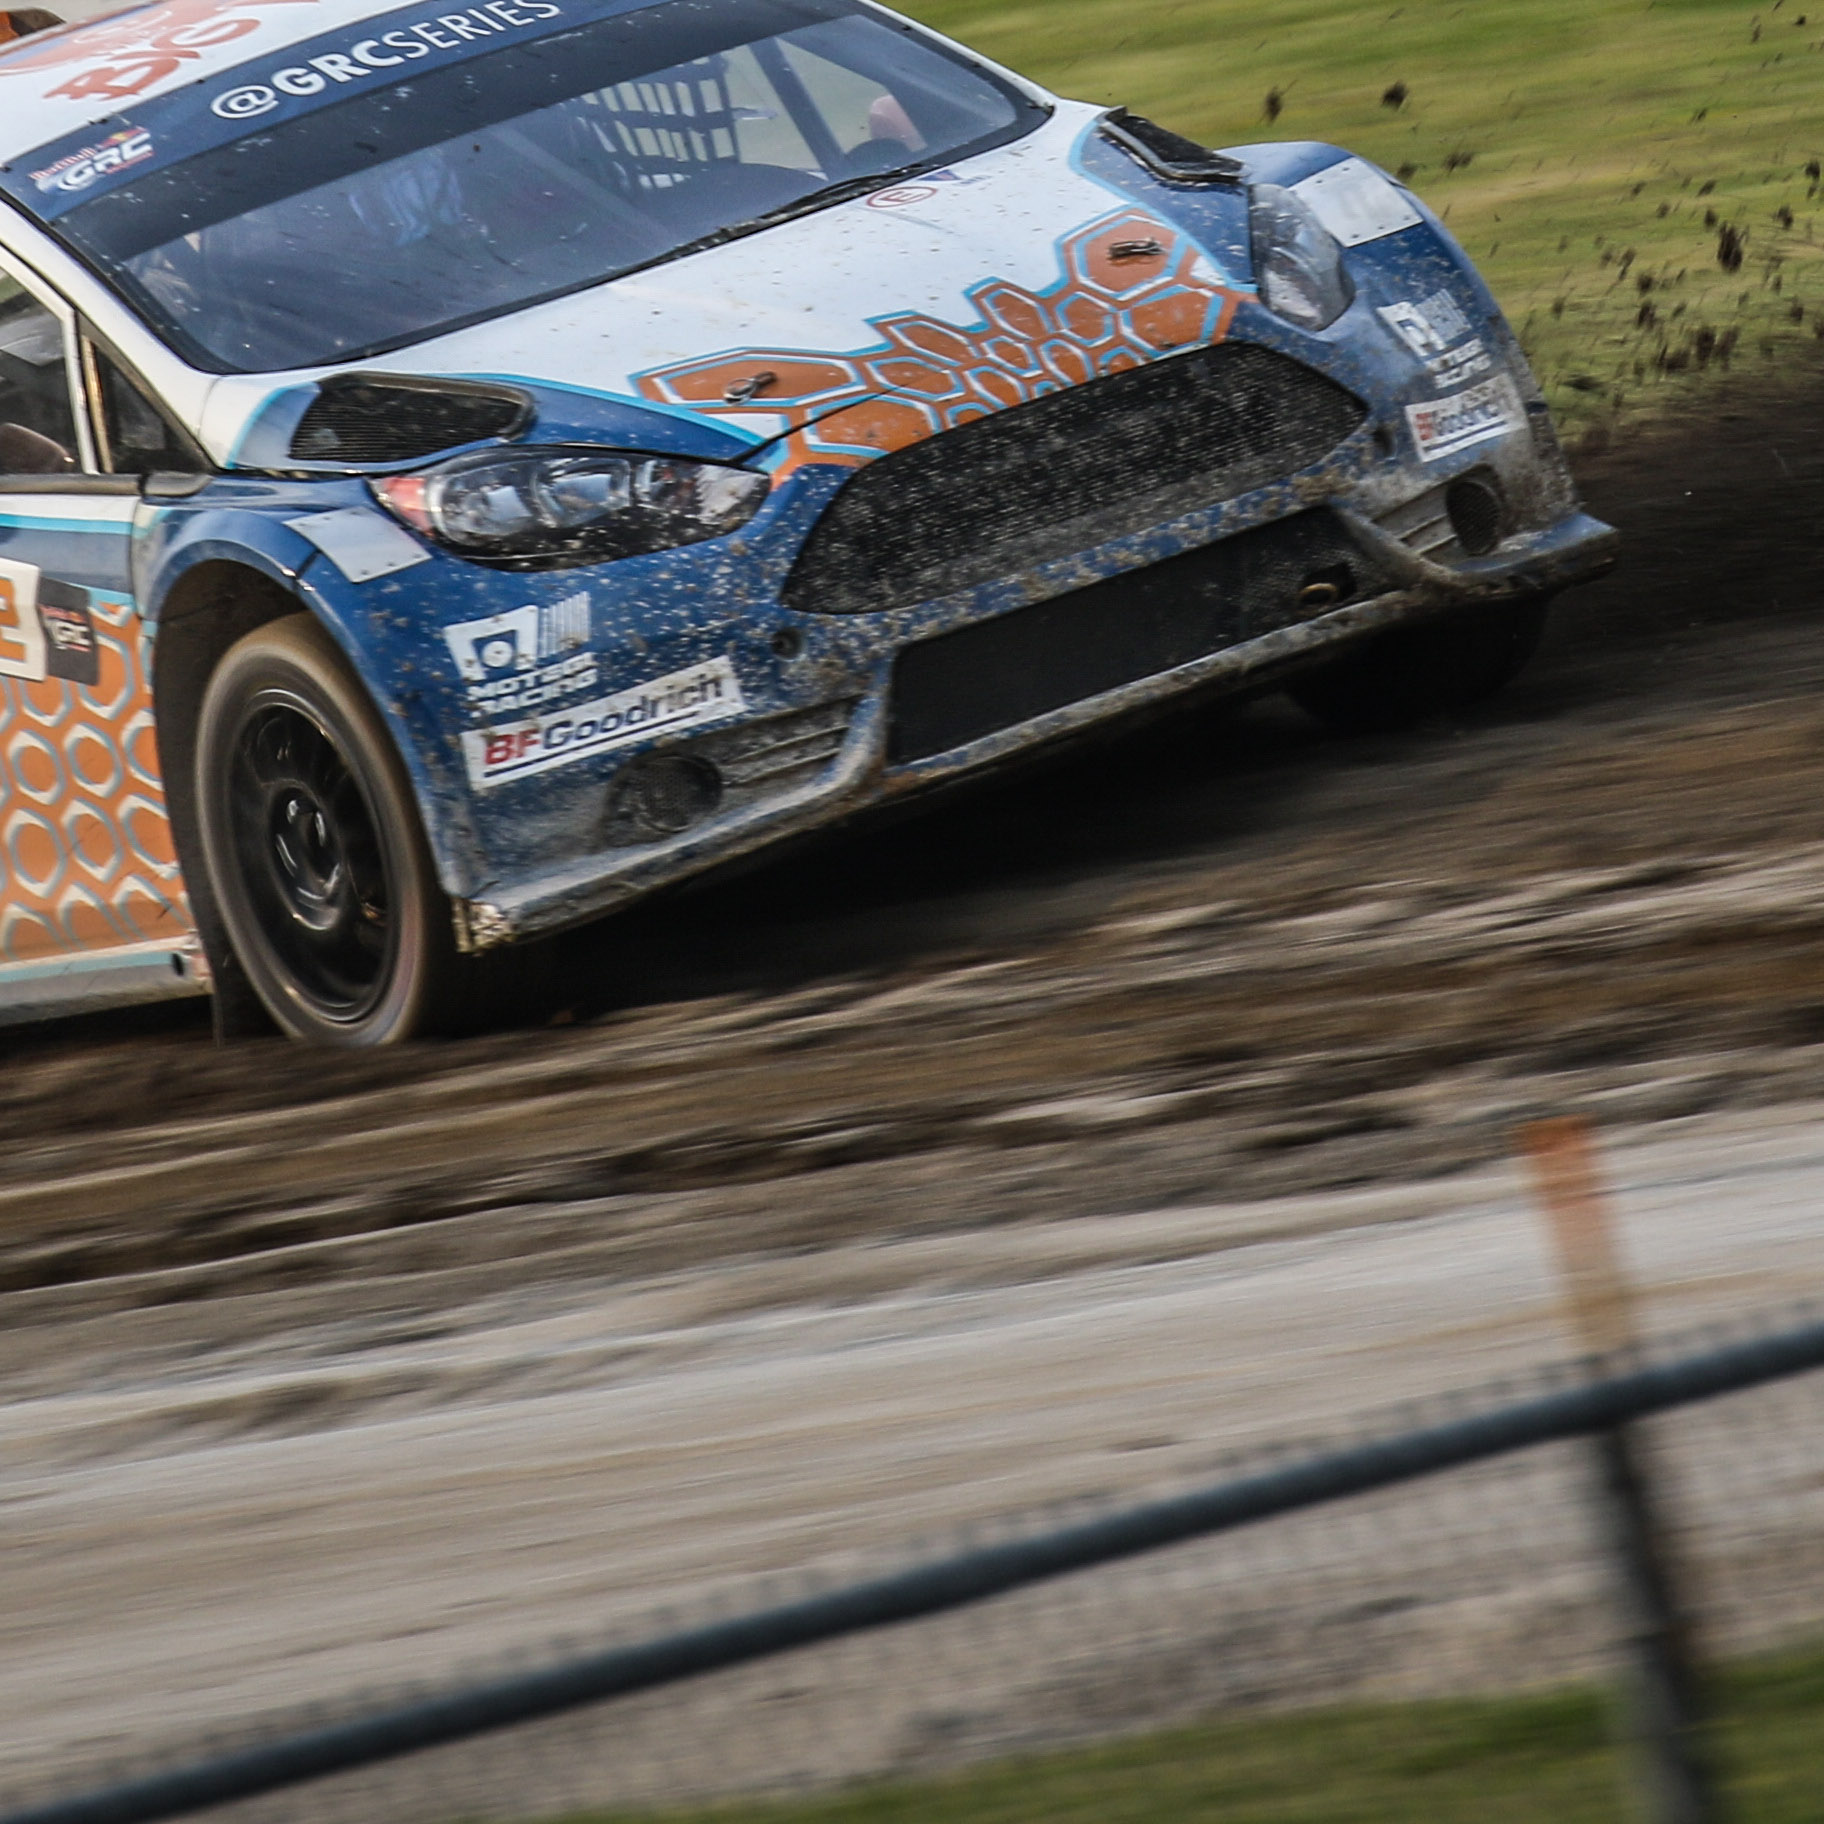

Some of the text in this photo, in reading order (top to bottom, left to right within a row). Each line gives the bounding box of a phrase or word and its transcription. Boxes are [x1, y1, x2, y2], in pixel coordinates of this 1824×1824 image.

[42, 18, 262, 102] BIG
[57, 132, 153, 191] GRC
[484, 672, 723, 766] BFGoodrich
